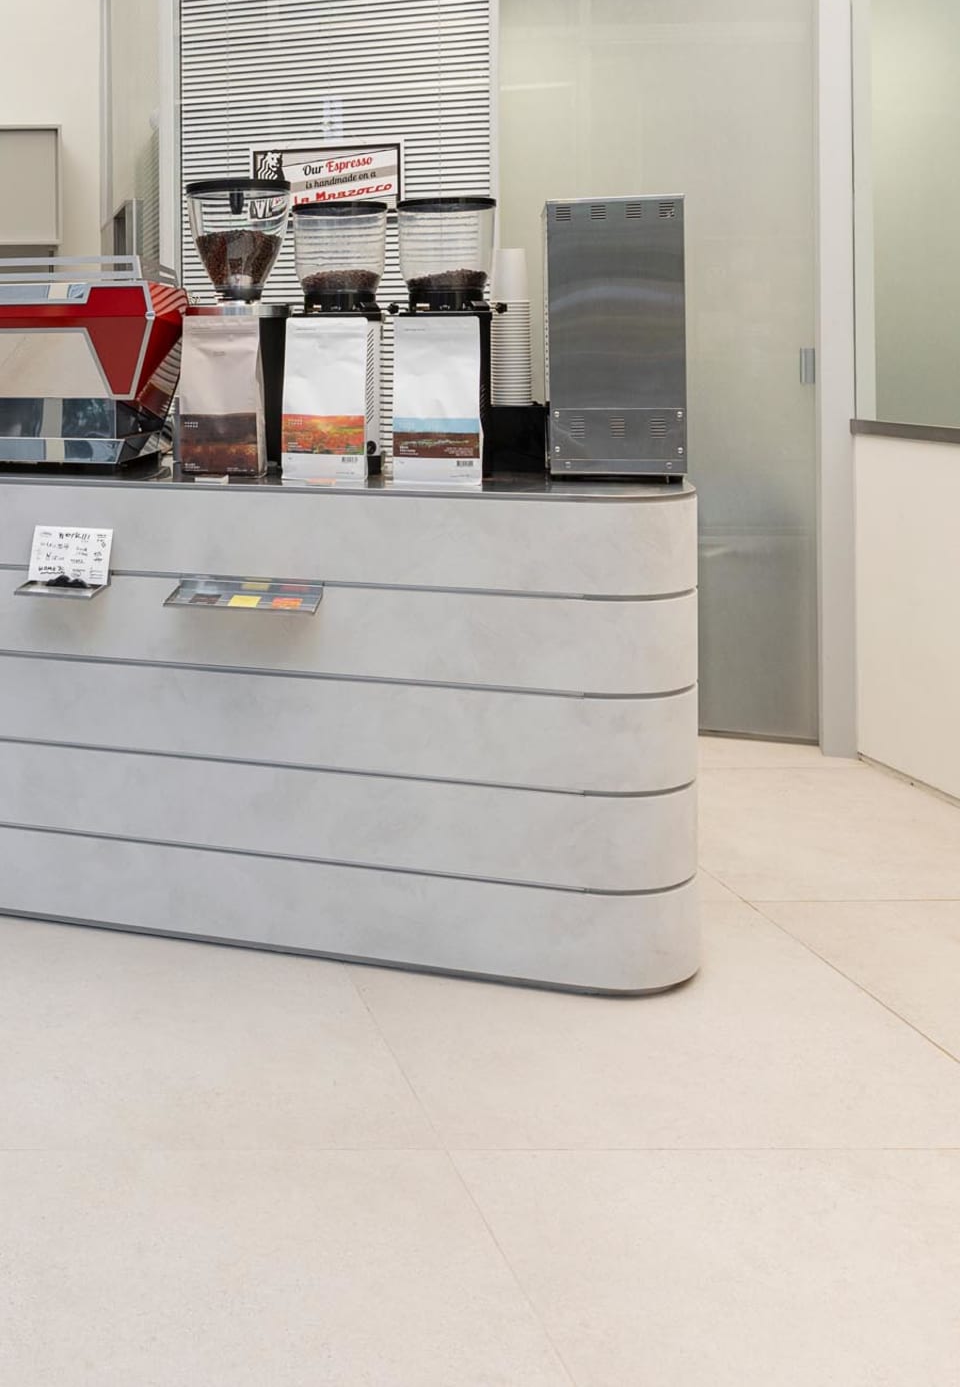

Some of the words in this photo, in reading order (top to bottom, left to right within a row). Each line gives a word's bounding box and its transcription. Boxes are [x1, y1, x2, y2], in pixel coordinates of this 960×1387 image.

[302, 164, 324, 176] Our
[325, 156, 373, 173] Espresso
[305, 181, 313, 190] is
[314, 173, 357, 188] handmade
[358, 172, 369, 180] on
